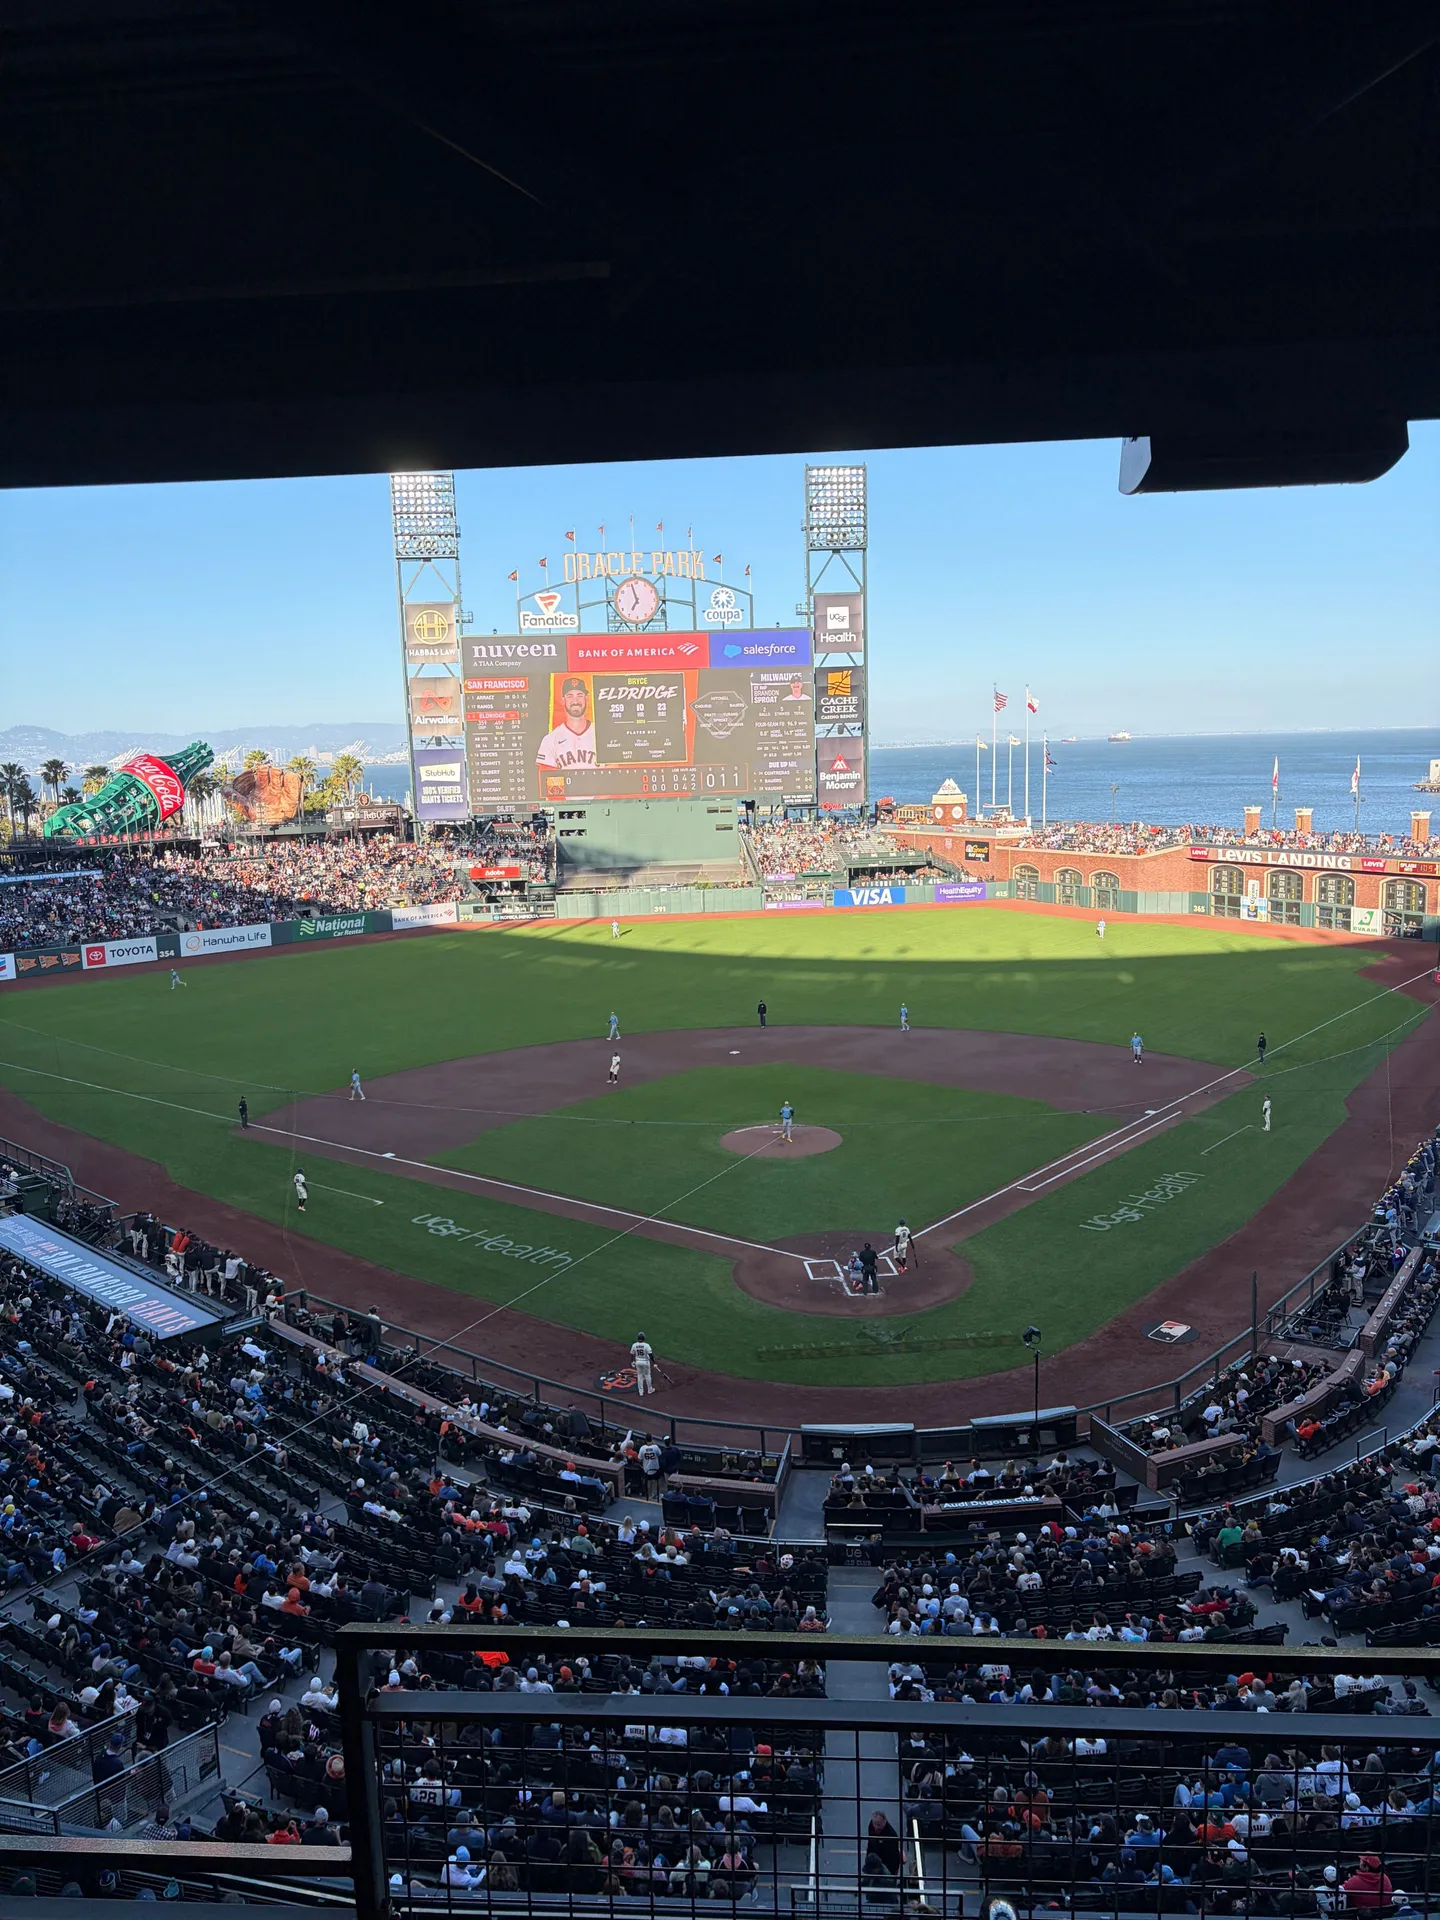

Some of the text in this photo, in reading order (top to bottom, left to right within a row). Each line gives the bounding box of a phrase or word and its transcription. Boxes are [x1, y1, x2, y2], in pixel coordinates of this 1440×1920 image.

[564, 550, 705, 583] ORACLE PARK
[522, 614, 576, 626] Fanatics
[706, 609, 740, 621] coupa
[829, 613, 846, 623] UCSF
[820, 632, 857, 643] Health
[440, 648, 456, 656] LAW
[472, 642, 557, 658] nuveen
[578, 648, 675, 658] BANK OF AMERICA
[743, 644, 796, 657] salesforce
[467, 680, 525, 689] SAN FRANCISCO
[598, 685, 678, 701] ELDRIDGE
[754, 696, 778, 704] SPROAT
[821, 697, 858, 705] CACHE
[609, 703, 666, 712] .259 10 23
[822, 705, 857, 714] CREEK
[415, 716, 460, 724] Airwallex
[425, 769, 456, 777] StubHub
[820, 771, 861, 782] Benjamin
[126, 755, 181, 811] Coca-Cola
[706, 773, 715, 788] 0
[720, 773, 725, 787] 1
[733, 772, 738, 786] 1
[826, 780, 855, 790] Moore
[422, 786, 461, 795] 100% VERIFIED
[421, 794, 463, 804] GIANTS TICKETS
[1268, 852, 1351, 869] LANDING
[940, 886, 983, 895] HealthEquity
[847, 888, 892, 906] VISA
[1193, 905, 1205, 913] 365
[418, 912, 443, 920] AMERICA
[316, 916, 365, 932] National
[345, 928, 364, 936] Rental
[203, 931, 267, 947] Hanwha Life
[110, 945, 154, 958] TOYOTA
[159, 950, 175, 958] 354
[1079, 1171, 1205, 1231] UCSF Health
[411, 1213, 573, 1269] UCSF Health
[39, 1250, 197, 1333] SAN FRANCISCO GIANTS
[970, 1498, 1012, 1507] Dugout
[547, 1512, 571, 1525] blue
